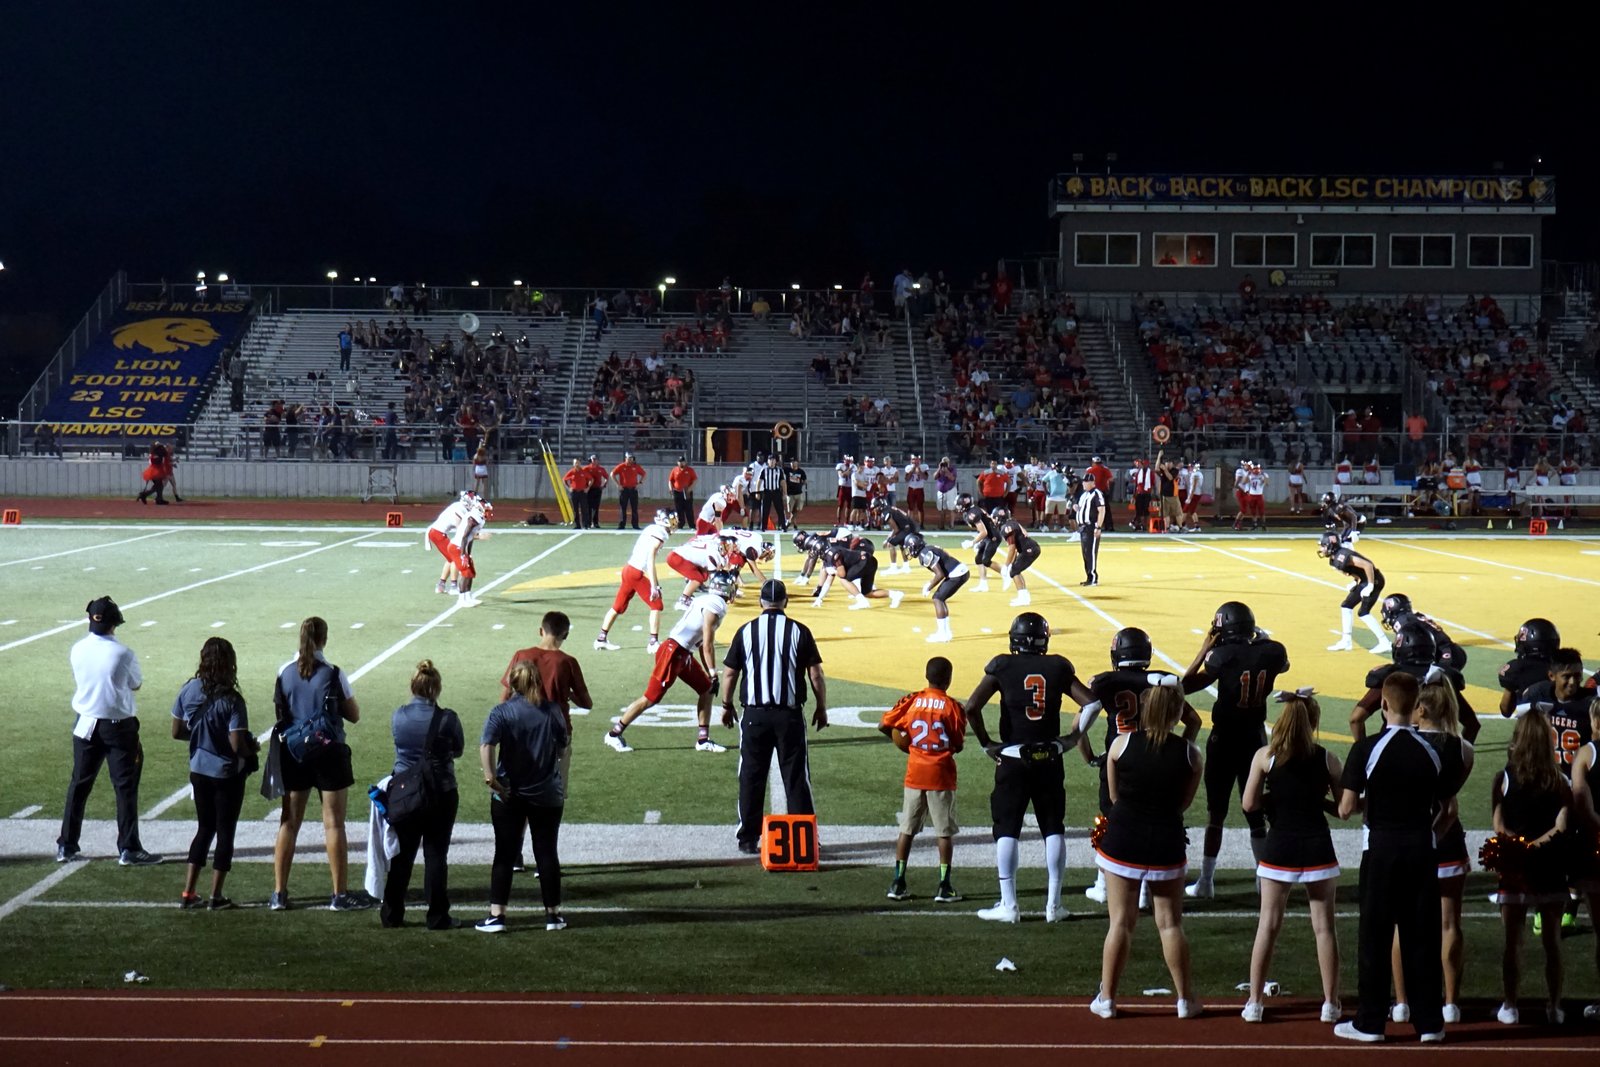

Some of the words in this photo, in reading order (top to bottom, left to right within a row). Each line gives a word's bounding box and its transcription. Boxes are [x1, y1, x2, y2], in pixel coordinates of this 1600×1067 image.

[1089, 176, 1154, 198] BACK
[1155, 181, 1167, 192] to
[1169, 176, 1234, 198] BACK
[1236, 181, 1248, 192] to
[1249, 177, 1314, 198] BACK
[1320, 177, 1369, 199] LSC
[1374, 178, 1523, 200] CHAMPIONS
[125, 301, 167, 312] BEST
[169, 301, 189, 312] IN
[191, 302, 245, 313] CLASS
[114, 359, 182, 371] LION
[69, 374, 202, 387] FOOTBALL
[69, 390, 105, 402] 23
[119, 391, 188, 403] TIME
[89, 406, 147, 418] LSC
[5, 511, 17, 523] 10
[388, 513, 401, 526] 20
[1531, 521, 1545, 533] 50
[1235, 669, 1267, 709] 11
[1023, 673, 1047, 721] 3
[1113, 687, 1151, 735] 2
[1551, 715, 1578, 728] IGERS
[911, 719, 950, 751] 23
[768, 820, 815, 865] 30
